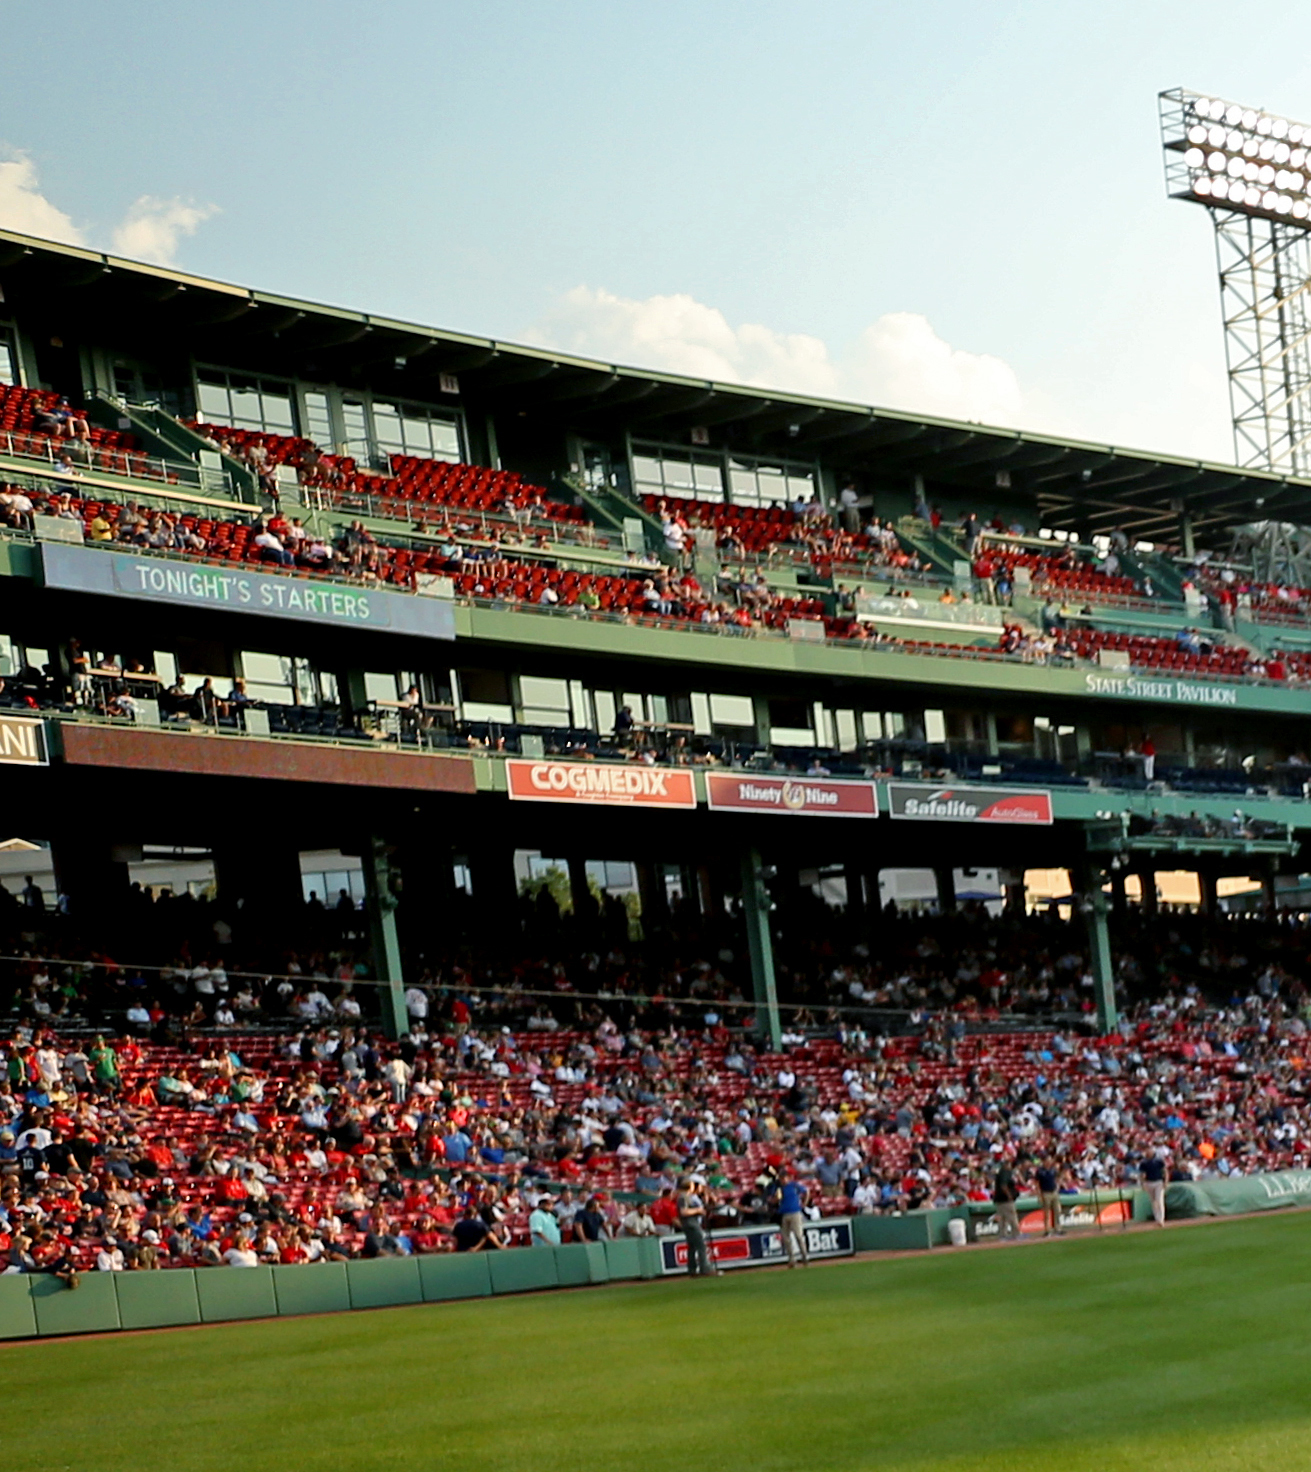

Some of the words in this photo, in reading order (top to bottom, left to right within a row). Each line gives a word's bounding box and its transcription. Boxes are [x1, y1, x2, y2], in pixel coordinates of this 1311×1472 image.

[136, 565, 251, 603] TONIGHT'S
[260, 583, 371, 619] STARTERS
[1085, 673, 1126, 694] STATE
[1126, 677, 1173, 699] STREET
[1176, 681, 1237, 704] PAVILION
[0, 724, 36, 757] NI
[530, 765, 668, 796] COGMEDIX
[739, 783, 782, 804] Ninety
[805, 787, 839, 805] Nine
[904, 798, 977, 817] Safelite
[807, 1227, 840, 1252] Bat
